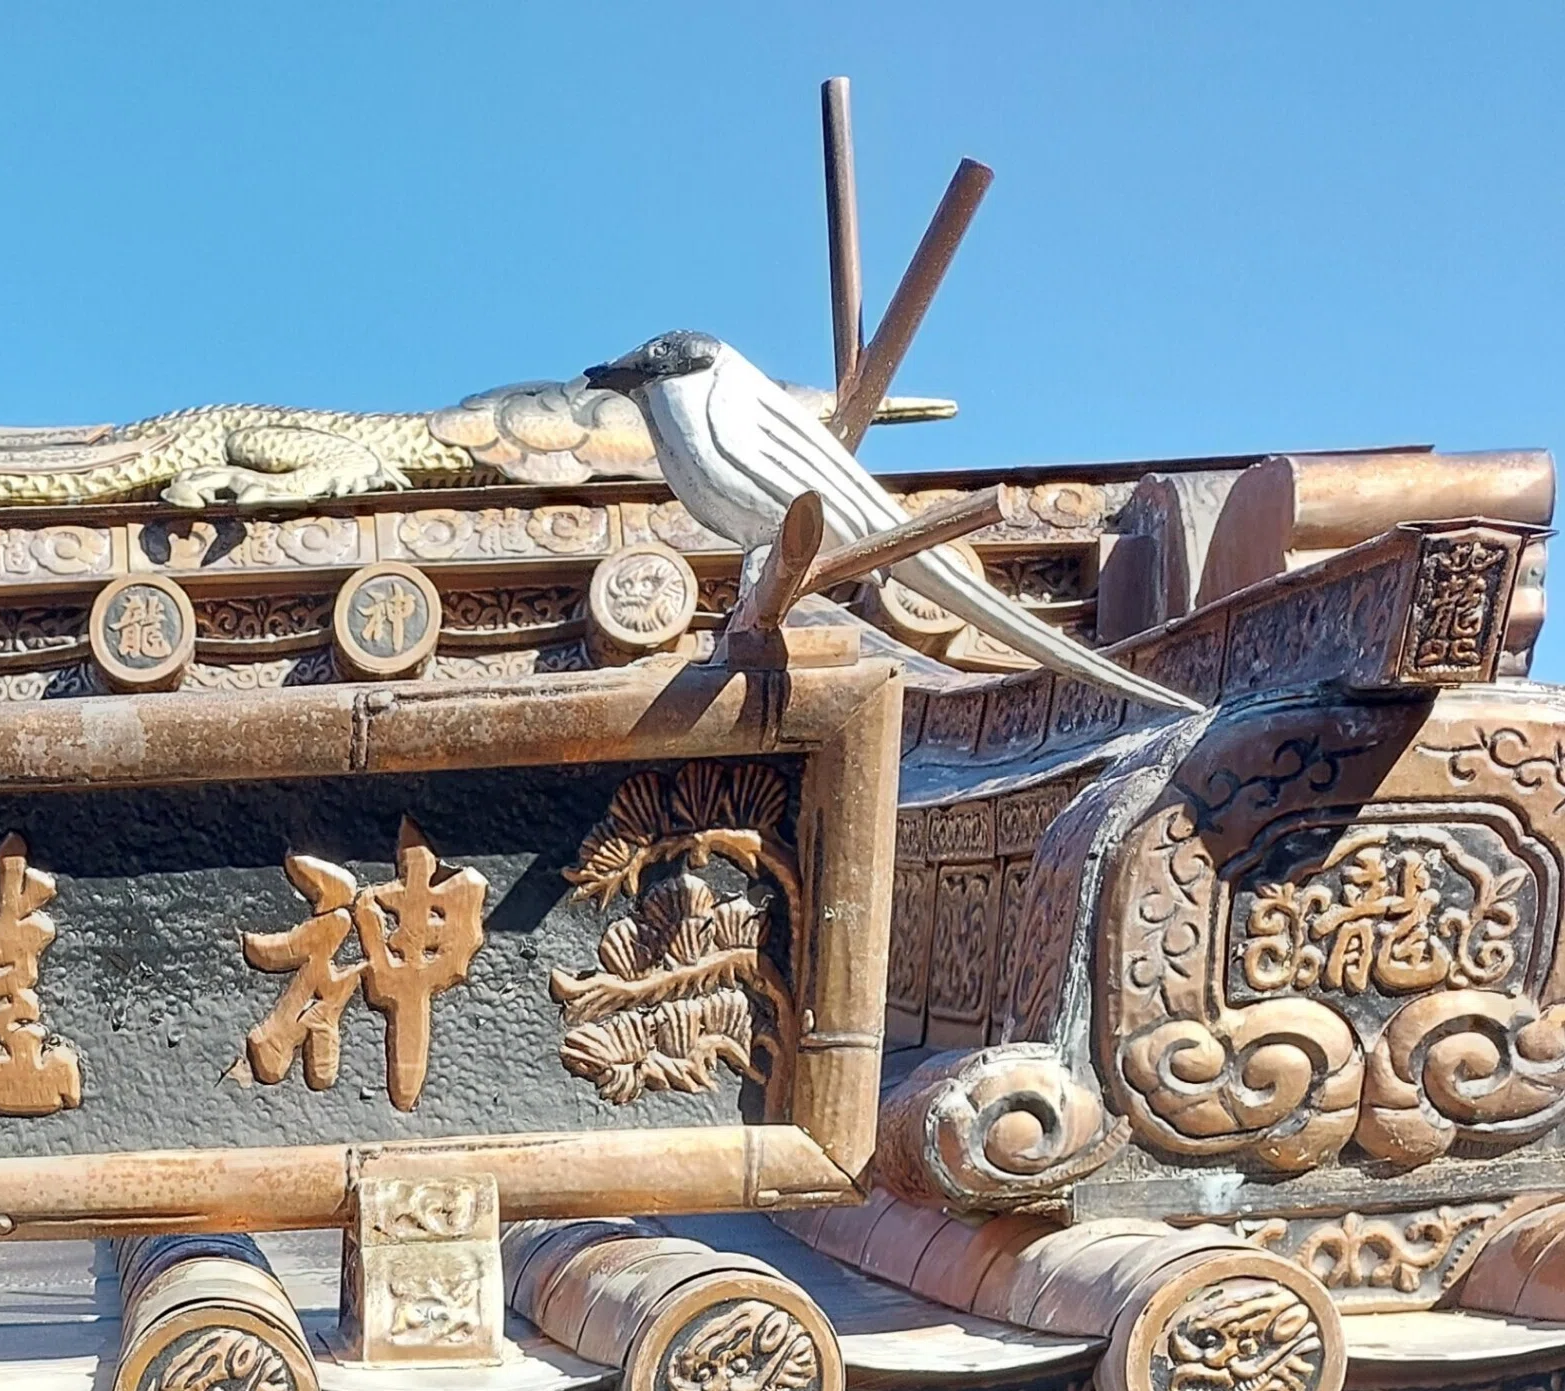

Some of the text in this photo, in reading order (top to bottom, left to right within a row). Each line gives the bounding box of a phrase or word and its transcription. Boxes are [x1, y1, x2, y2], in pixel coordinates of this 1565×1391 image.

[108, 594, 172, 659] 龍
[357, 581, 417, 653] 神
[1311, 848, 1450, 994] 龍
